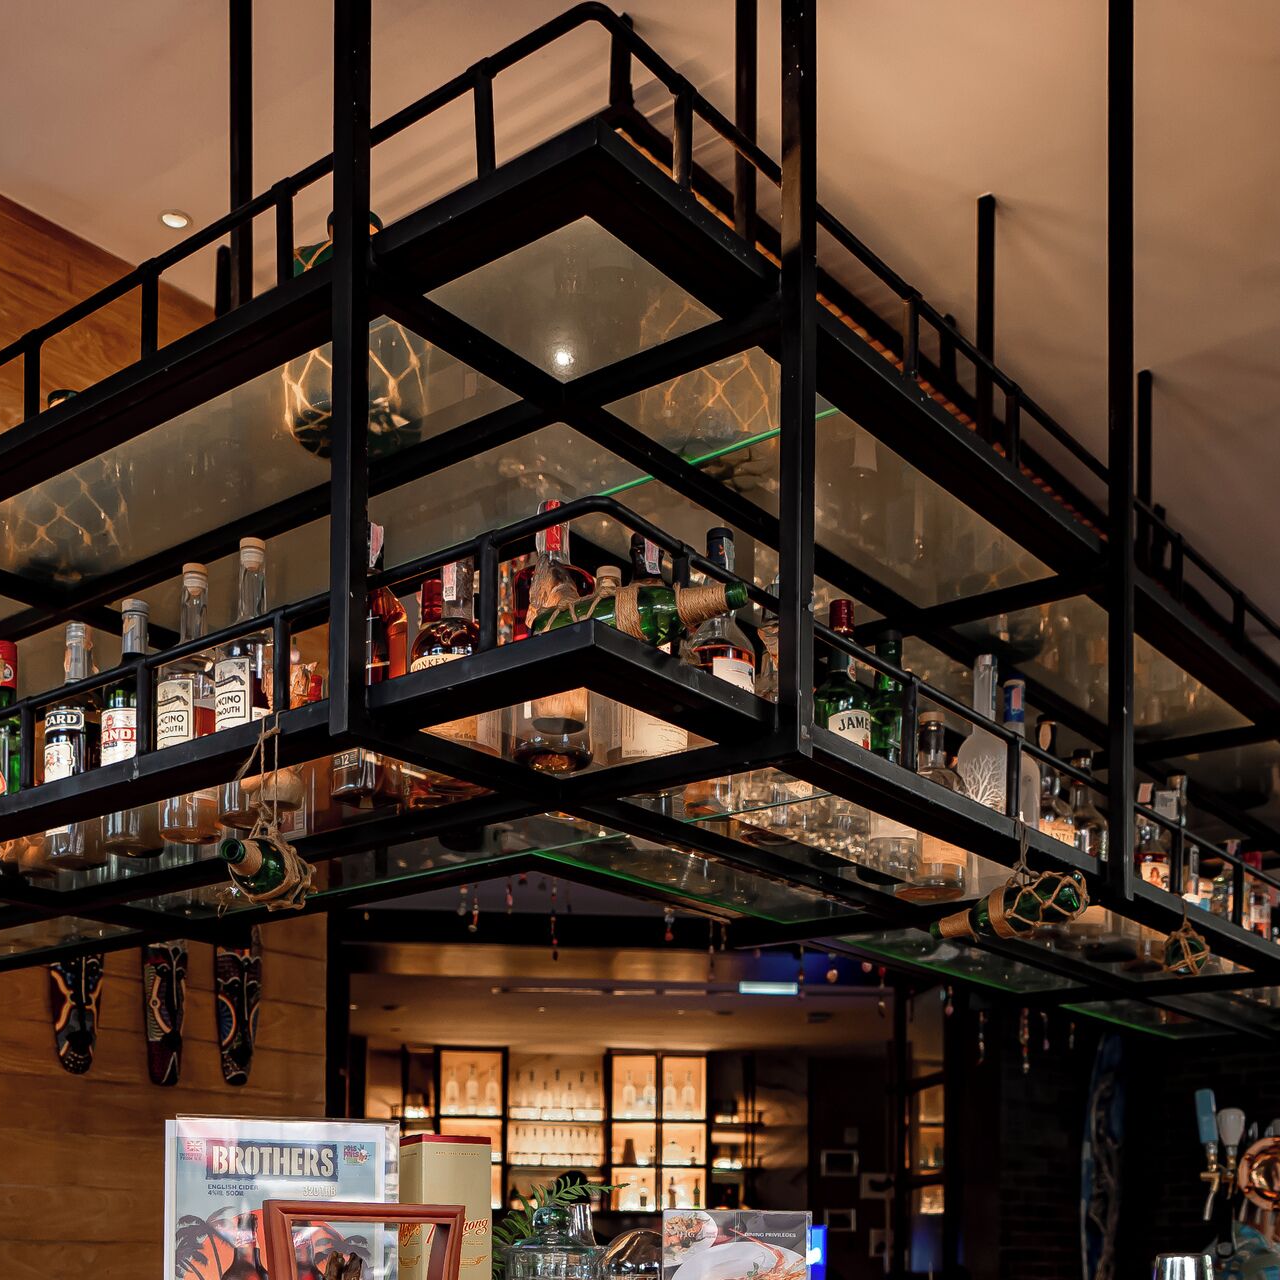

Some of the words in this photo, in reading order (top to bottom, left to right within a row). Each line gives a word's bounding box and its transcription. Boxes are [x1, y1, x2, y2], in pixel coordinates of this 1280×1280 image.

[837, 715, 870, 733] JAME
[340, 754, 350, 765] 12
[212, 1145, 334, 1178] BROTHERS
